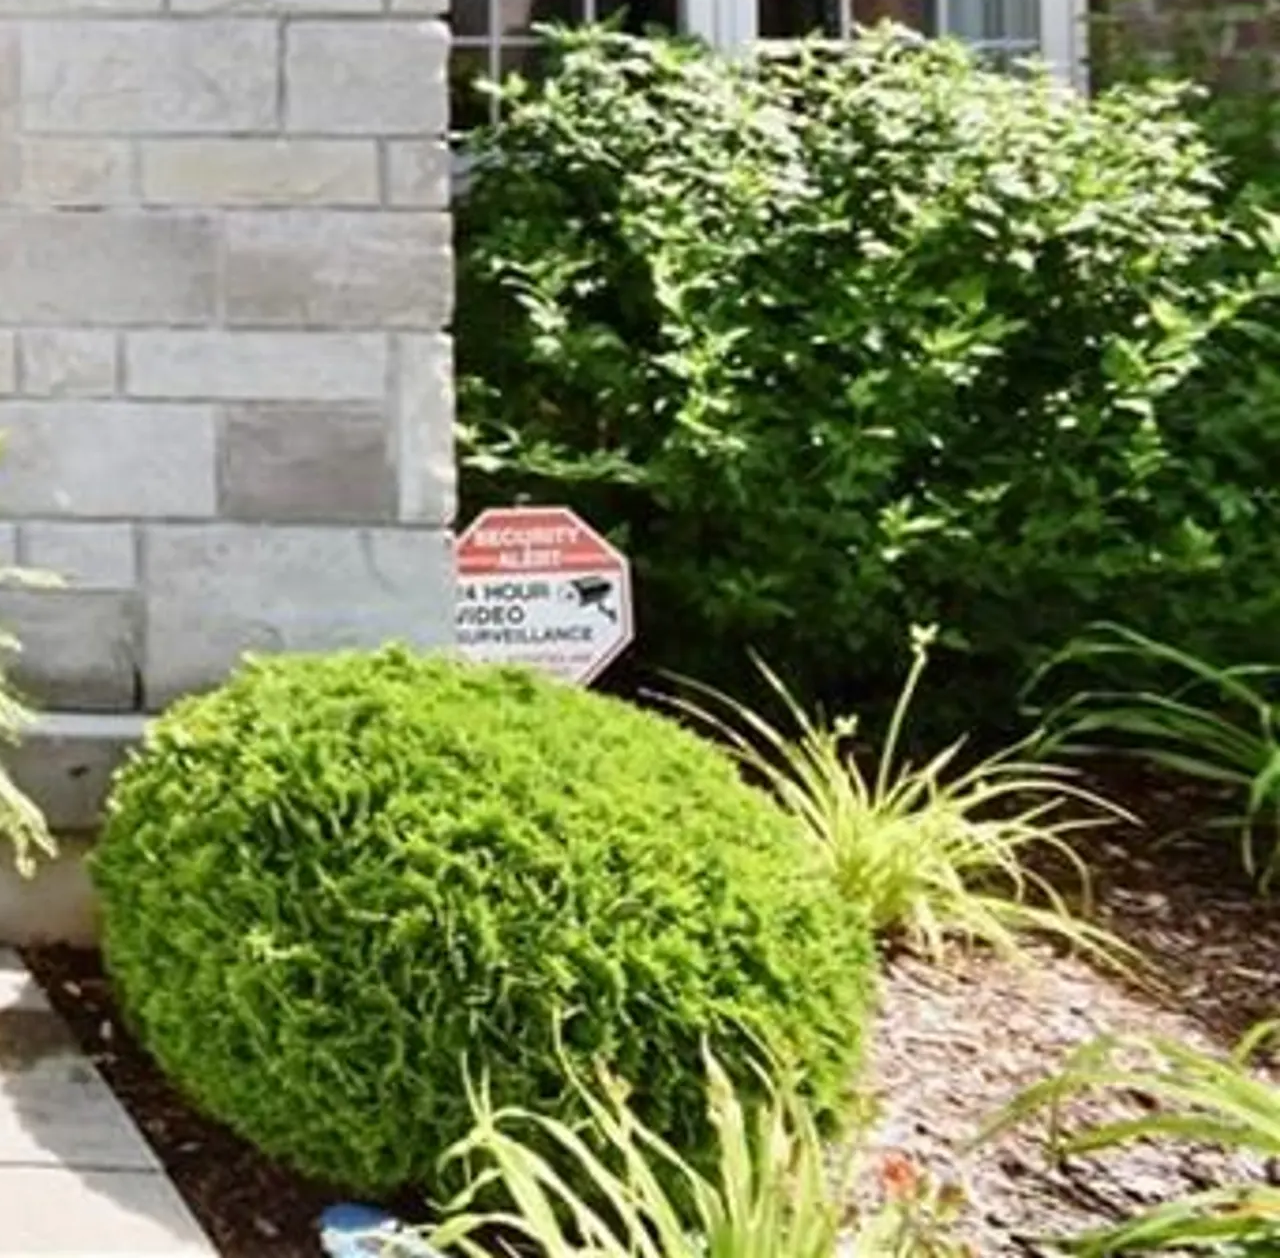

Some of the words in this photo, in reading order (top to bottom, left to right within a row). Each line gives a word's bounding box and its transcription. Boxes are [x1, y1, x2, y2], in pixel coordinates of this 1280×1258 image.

[473, 526, 579, 546] SECURITY
[498, 548, 562, 568] ALERT
[484, 582, 551, 599] HOUR
